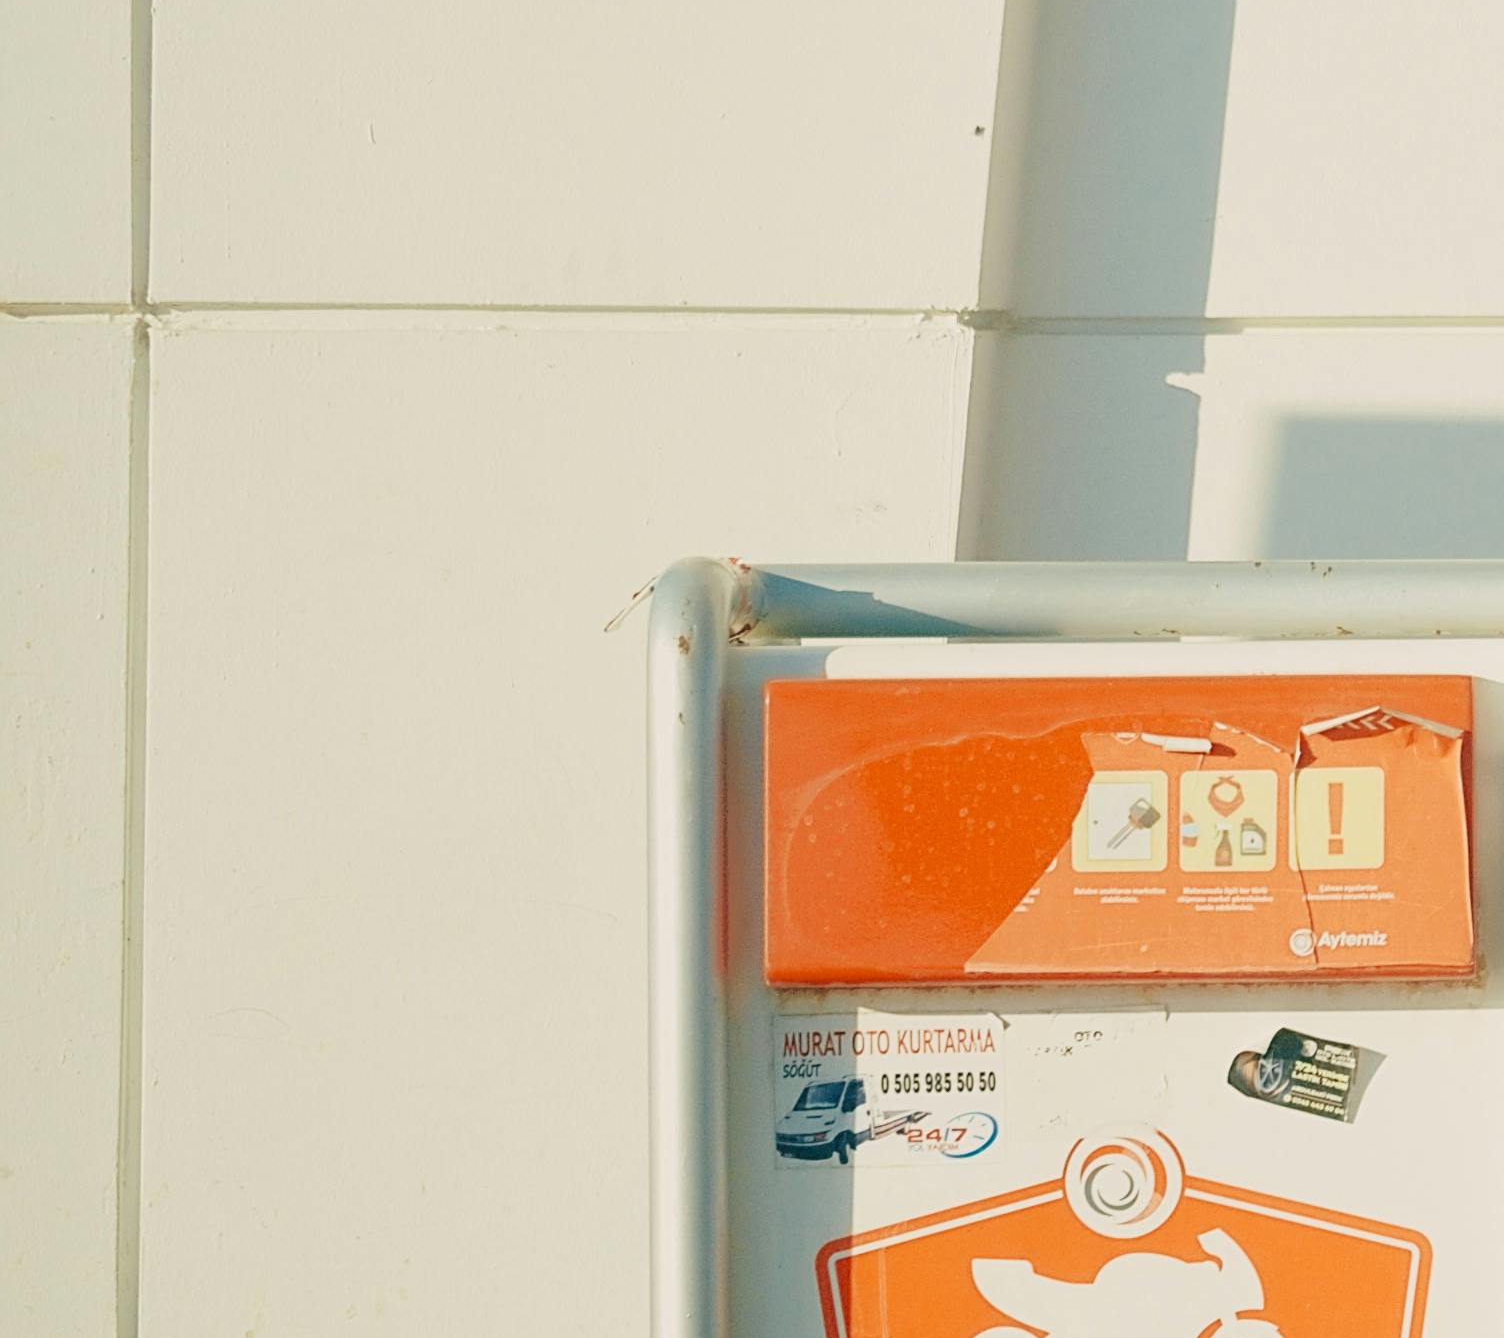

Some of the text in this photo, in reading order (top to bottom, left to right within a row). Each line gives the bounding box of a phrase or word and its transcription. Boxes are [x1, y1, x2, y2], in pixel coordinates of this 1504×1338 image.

[1317, 930, 1388, 949] Aytemiz
[783, 1030, 846, 1057] MURAT
[852, 1029, 890, 1055] OTO
[897, 1028, 996, 1054] KURTARMA
[783, 1059, 821, 1079] SÖĞÜT
[881, 1071, 997, 1094] 0 505 985 50 50
[907, 1127, 968, 1143] 24/7
